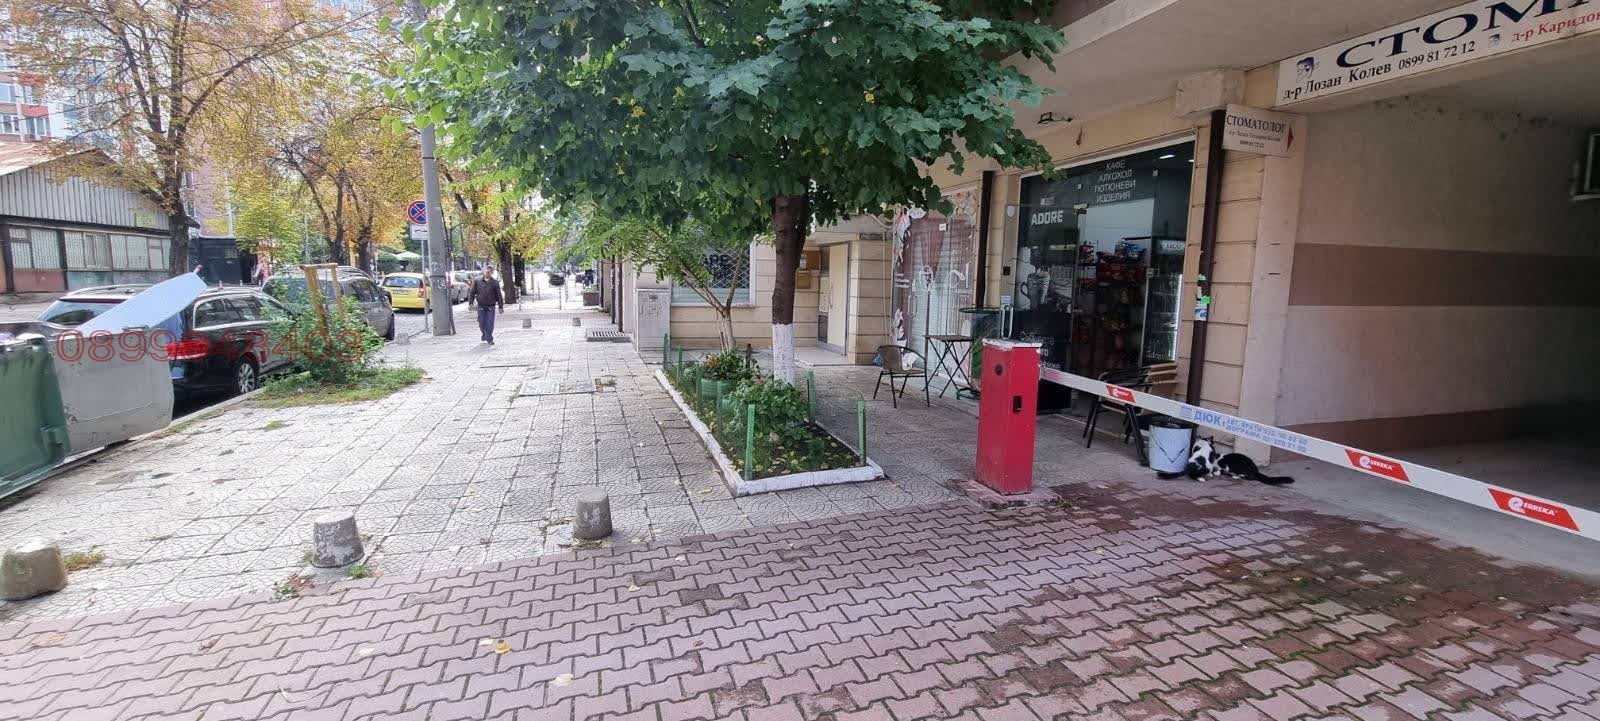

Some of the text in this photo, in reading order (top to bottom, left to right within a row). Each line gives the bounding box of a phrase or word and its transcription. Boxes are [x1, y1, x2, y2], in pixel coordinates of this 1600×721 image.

[1337, 0, 1589, 67] СТОМ
[1512, 29, 1534, 41] д-р
[1283, 41, 1475, 100] д-р Лозан Колев 0899 81 72 12
[1226, 115, 1286, 133] СТОМАТОЛОГ
[1106, 160, 1125, 170] КАФЕ
[1098, 169, 1132, 182] АЛКОХОЛ
[1031, 210, 1063, 225] ADORE
[1523, 502, 1555, 516] ERREKA
